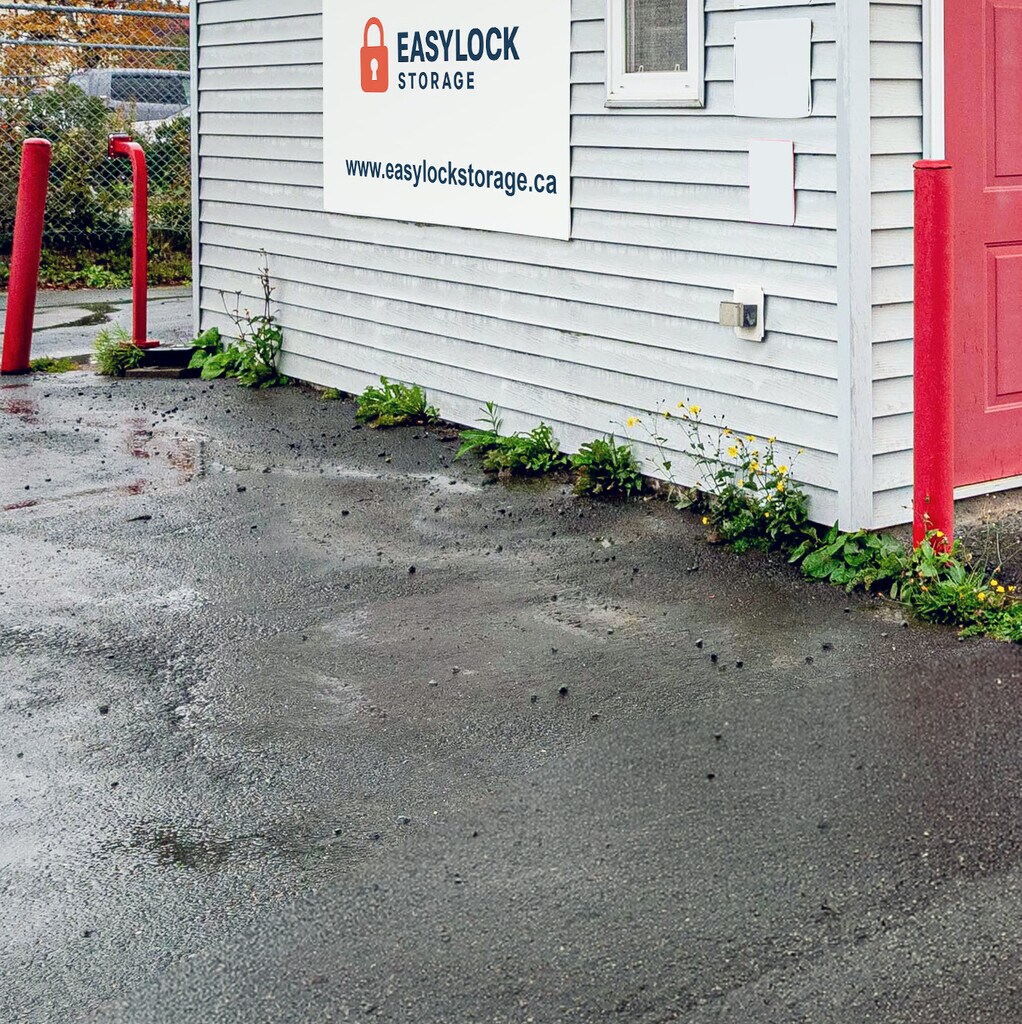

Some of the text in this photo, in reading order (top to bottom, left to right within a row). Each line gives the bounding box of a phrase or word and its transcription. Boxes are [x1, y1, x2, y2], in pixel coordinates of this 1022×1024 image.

[397, 26, 520, 62] EASYLOCK
[398, 71, 475, 90] STORAGE
[345, 159, 557, 197] www.easylockstorage.ca
